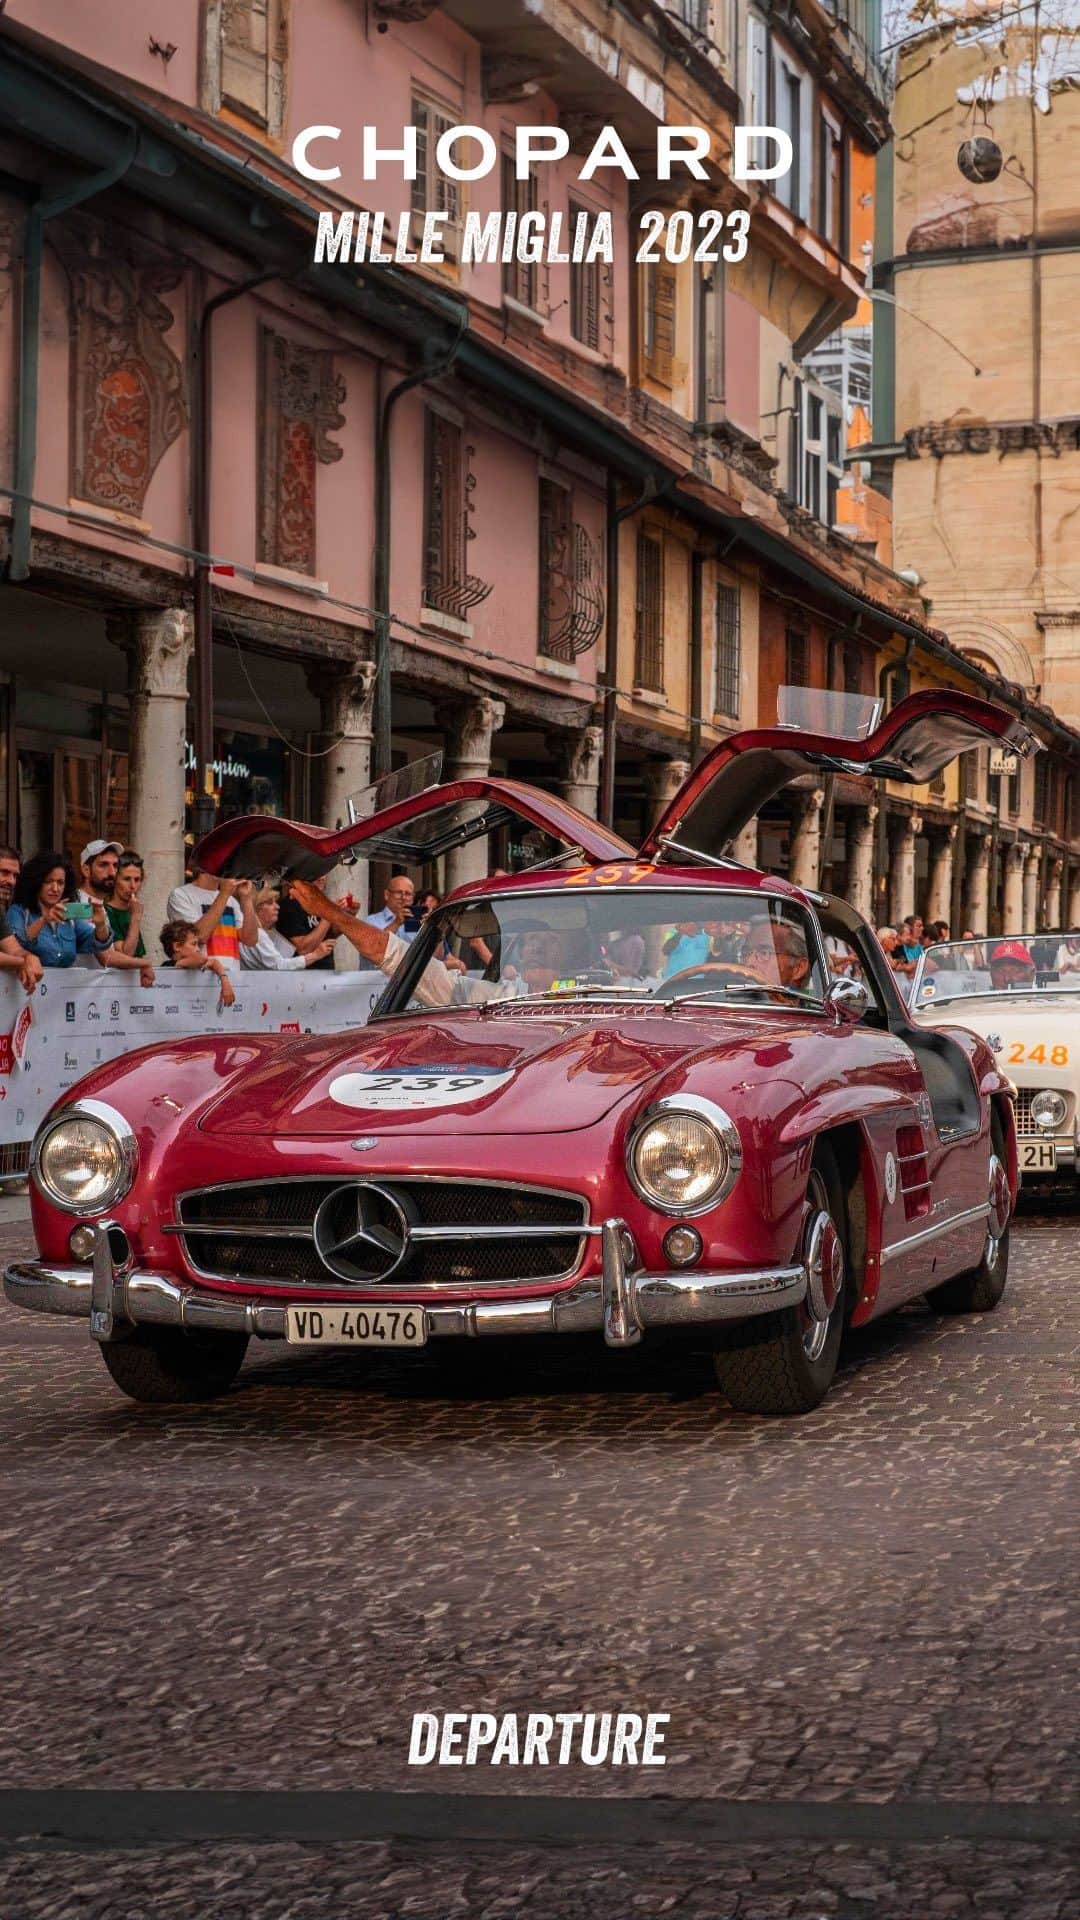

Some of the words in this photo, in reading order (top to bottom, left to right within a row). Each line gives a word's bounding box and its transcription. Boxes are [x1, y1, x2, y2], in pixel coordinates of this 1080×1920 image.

[1008, 1043, 1069, 1067] 248
[359, 1077, 485, 1092] 239
[1017, 1145, 1053, 1167] 2H
